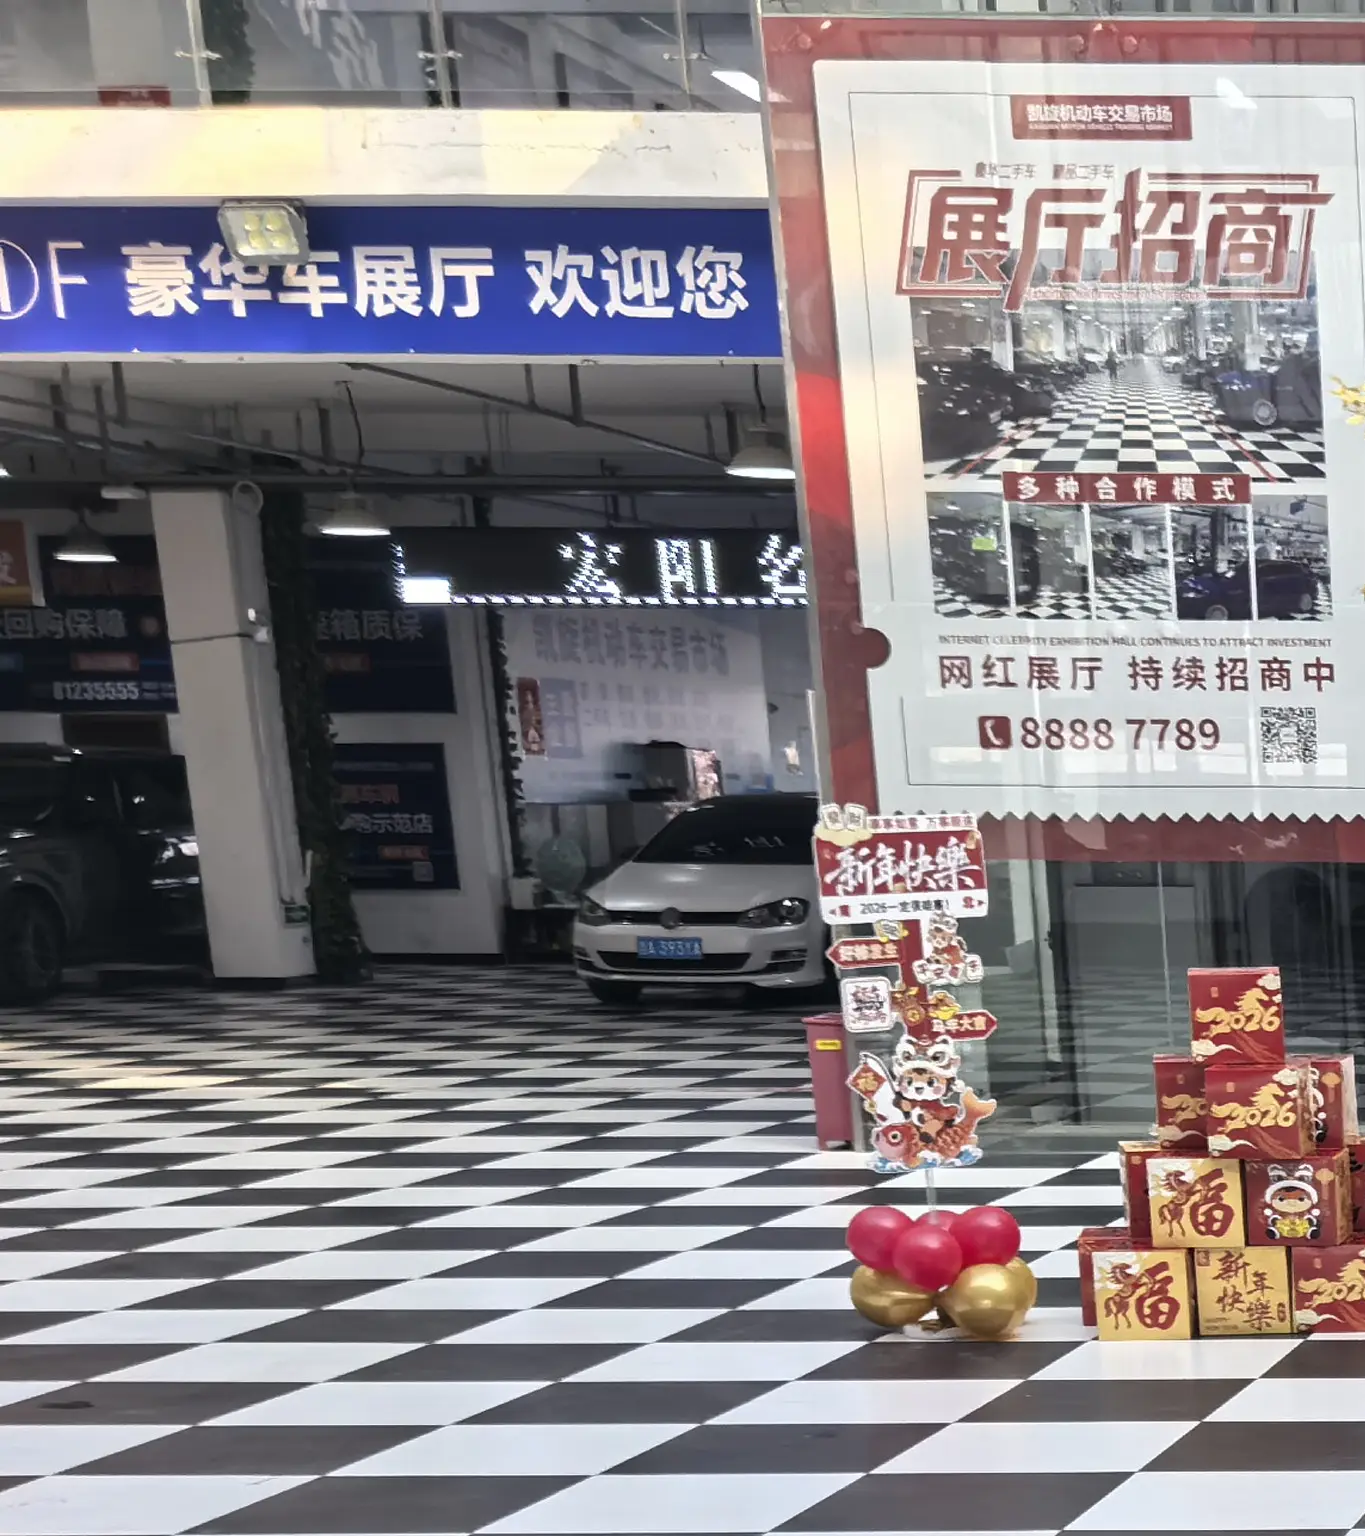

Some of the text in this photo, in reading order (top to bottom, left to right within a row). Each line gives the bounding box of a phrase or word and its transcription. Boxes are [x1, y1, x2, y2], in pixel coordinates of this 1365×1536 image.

[919, 167, 1334, 313] 展厅招商
[120, 243, 495, 320] 豪华车展厅
[525, 245, 750, 321] 欢迎您
[1015, 475, 1239, 504] 多种合作模式
[1203, 638, 1217, 647] TO
[939, 654, 1336, 693] 网红展厅 持续招商中
[1020, 716, 1221, 752] 8888 7789
[1199, 1005, 1281, 1037] 2026
[1215, 1103, 1297, 1134] 2026
